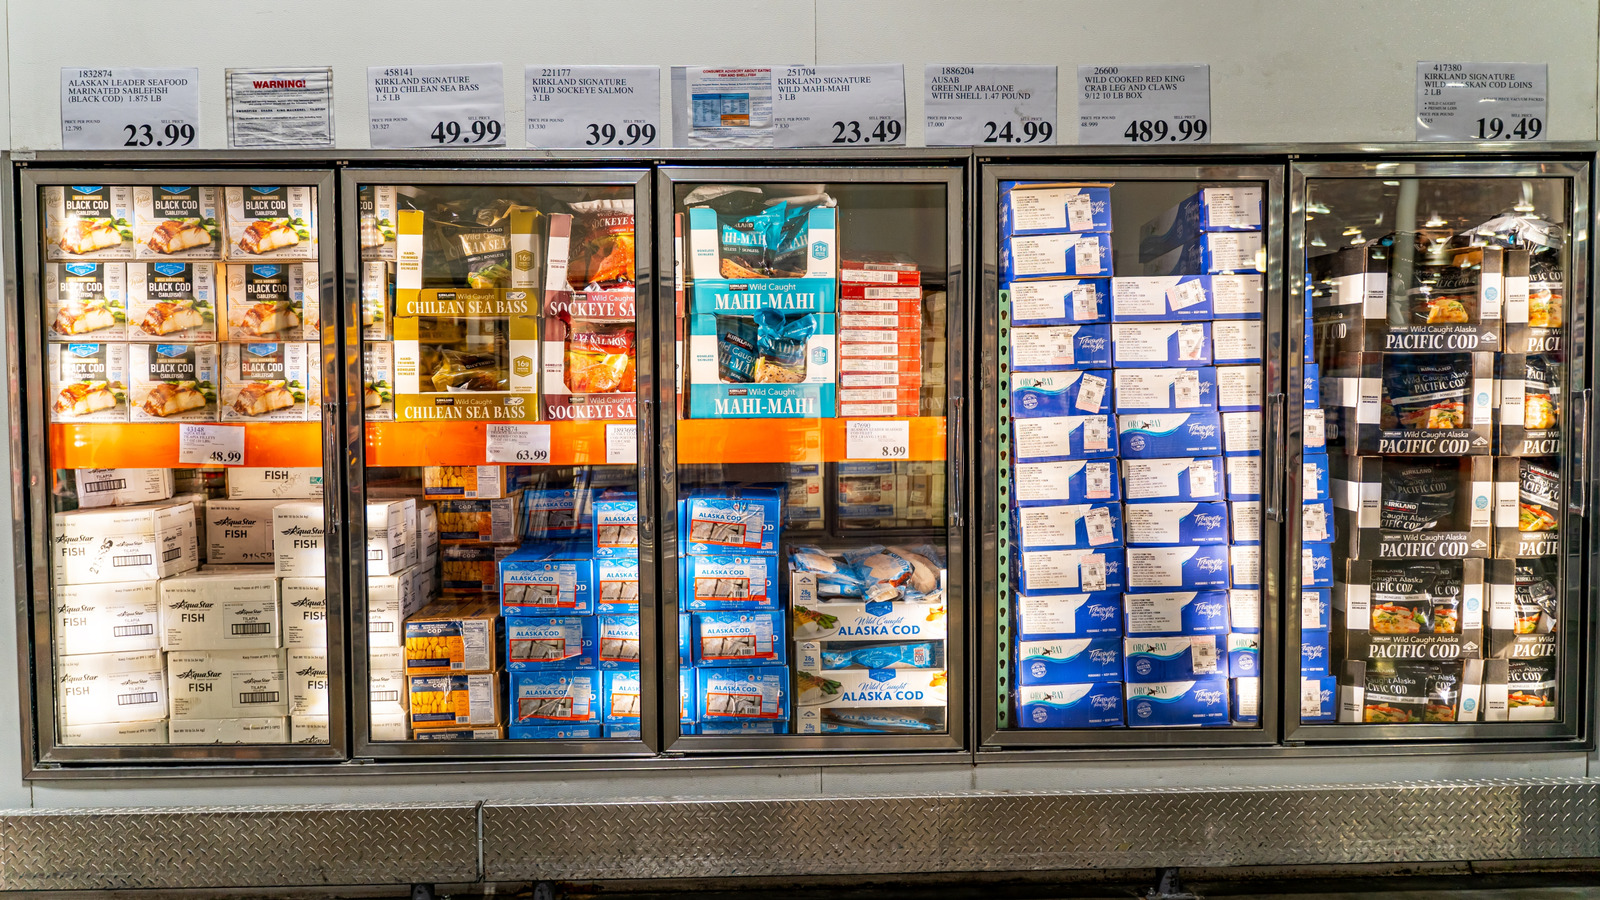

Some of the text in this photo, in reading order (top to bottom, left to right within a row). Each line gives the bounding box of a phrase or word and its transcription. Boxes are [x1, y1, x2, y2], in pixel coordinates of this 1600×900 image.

[78, 70, 112, 78] 1832874
[384, 69, 413, 77] 458141
[541, 69, 571, 77] 221177
[941, 67, 974, 75] 1886204
[1093, 67, 1118, 75] 26600
[68, 78, 188, 87] ALASKAN LEADER SEAFOOD
[252, 80, 306, 89] WARNING!
[375, 76, 470, 86] KIRKLAND SIGNATURE
[532, 78, 627, 86] KIRKLAND SIGNATURE
[777, 77, 822, 85] KIRKLAND
[823, 76, 871, 84] SIGNATURE
[931, 76, 960, 84] AUSAB
[1085, 75, 1185, 84] WILD COOKED RED KING
[375, 84, 480, 94] WILD CHILEAN SEA BASS
[532, 86, 634, 94] WILD SOCKEYE SALMON
[778, 84, 851, 93] WILD MAHI-MAHI
[931, 84, 1014, 93] GREENLIP ABALONE
[1085, 83, 1178, 92] CRAB LEG AND CLAWS
[1450, 81, 1487, 89] SKAN
[68, 87, 168, 95] MARINATED SABLEFISH
[931, 92, 1031, 100] WITH SHELL 1.47 POUND
[1084, 92, 1101, 100] 9/12
[1112, 91, 1124, 99] LB
[1125, 91, 1143, 99] BOX
[68, 94, 162, 103] (BLACK COD) 1.875 LB
[375, 94, 387, 102] 1.5
[532, 94, 550, 102] 3 LB
[778, 93, 796, 101] 3 LB
[430, 120, 501, 144] 49.99
[832, 119, 902, 144] 23.49
[983, 121, 1053, 143] 24.99
[1124, 118, 1208, 143] 489.99
[1476, 117, 1542, 140] 19.49
[123, 123, 195, 147] 23.99
[585, 123, 656, 146] 39.99
[66, 200, 110, 210] BLACK COD
[155, 199, 198, 210] BLACK COD
[245, 200, 287, 210] BLACK COD
[148, 281, 191, 292] BLACK COD
[749, 283, 797, 292] Wild Caught
[472, 293, 495, 301] Caught
[714, 292, 815, 310] MAHI-MAHI
[406, 300, 528, 315] CHILEAN SEA BASS
[550, 302, 617, 317] SOCKEYE
[1410, 325, 1477, 334] Wild Caught Alaska
[1386, 334, 1478, 349] PACIFIC COD
[150, 363, 194, 373] BLACK COD
[714, 397, 815, 415] MAHI-MAHI
[404, 406, 526, 419] CHILEAN SEA BASS
[548, 404, 614, 419] SOCKEYE
[881, 446, 906, 456] 8.99
[1378, 439, 1470, 454] PACIFIC COD
[209, 451, 242, 463] 48.99
[516, 449, 547, 461] 63.99
[264, 470, 289, 480] FISH
[1380, 542, 1469, 557] PACIFIC COD
[181, 613, 205, 623] FISH
[855, 616, 904, 628] Wild Caught
[838, 625, 921, 636] ALASKA COD
[1368, 644, 1460, 658] PACIFIC COD
[842, 690, 924, 702] ALASKA COD
